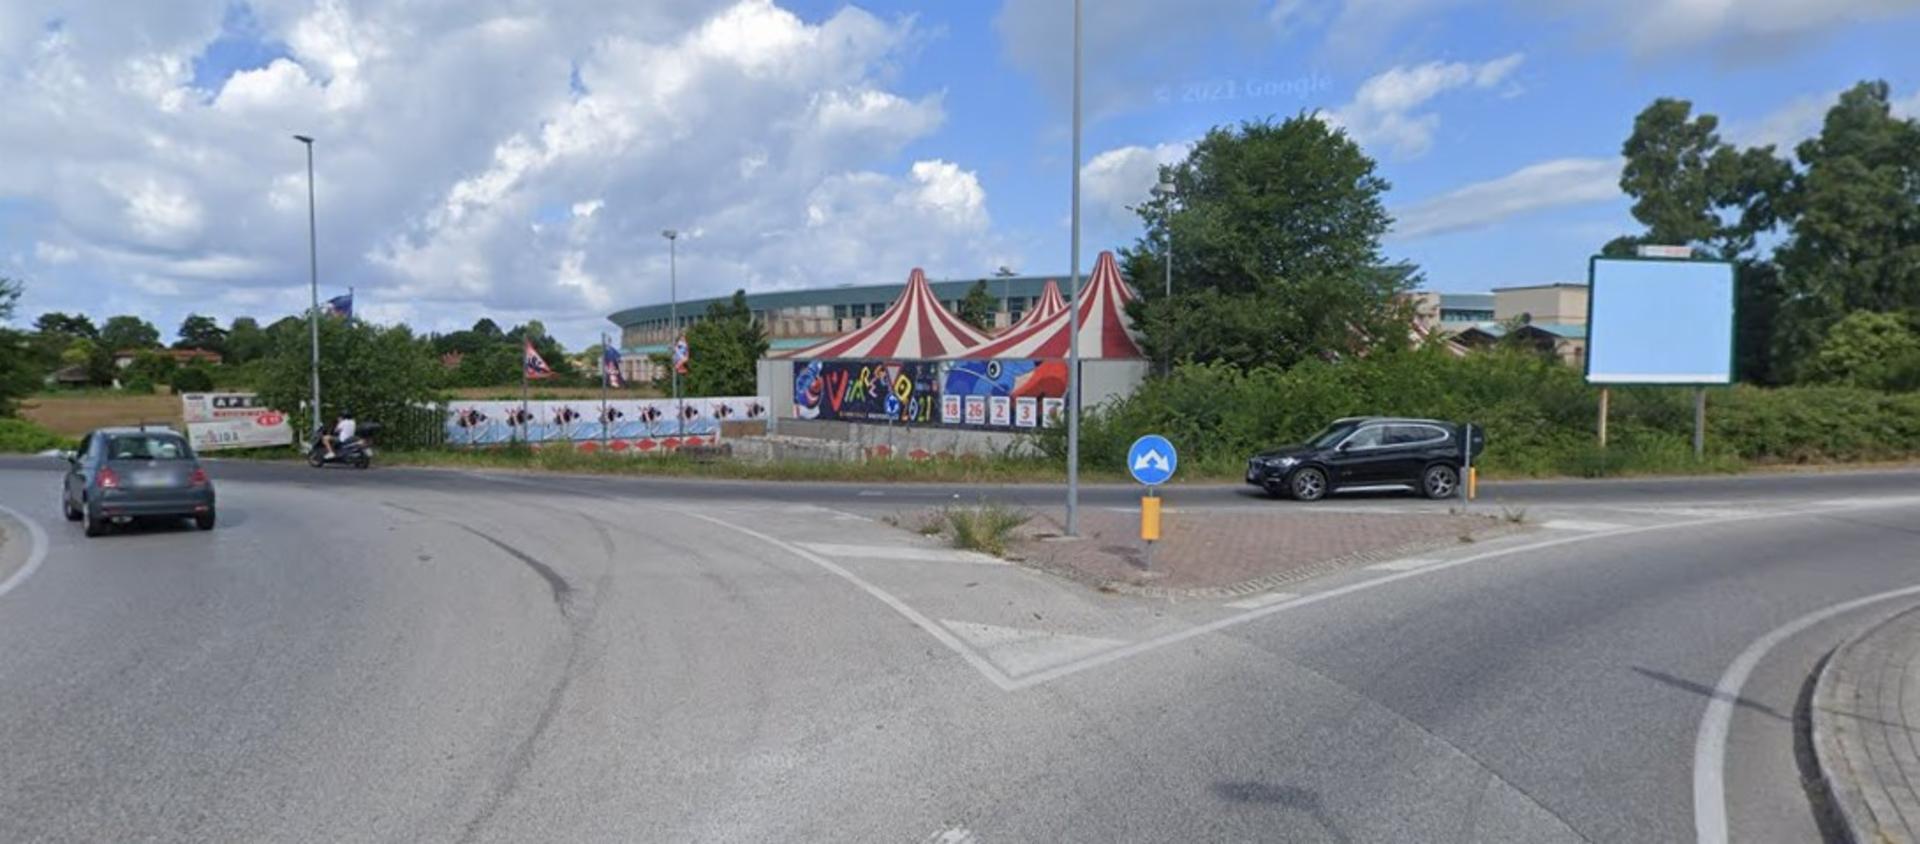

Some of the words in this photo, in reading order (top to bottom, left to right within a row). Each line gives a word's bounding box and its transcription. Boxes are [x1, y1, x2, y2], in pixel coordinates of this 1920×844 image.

[945, 403, 958, 416] 18
[969, 403, 982, 417] 26
[995, 405, 1004, 418] 2
[1021, 406, 1030, 420] 3
